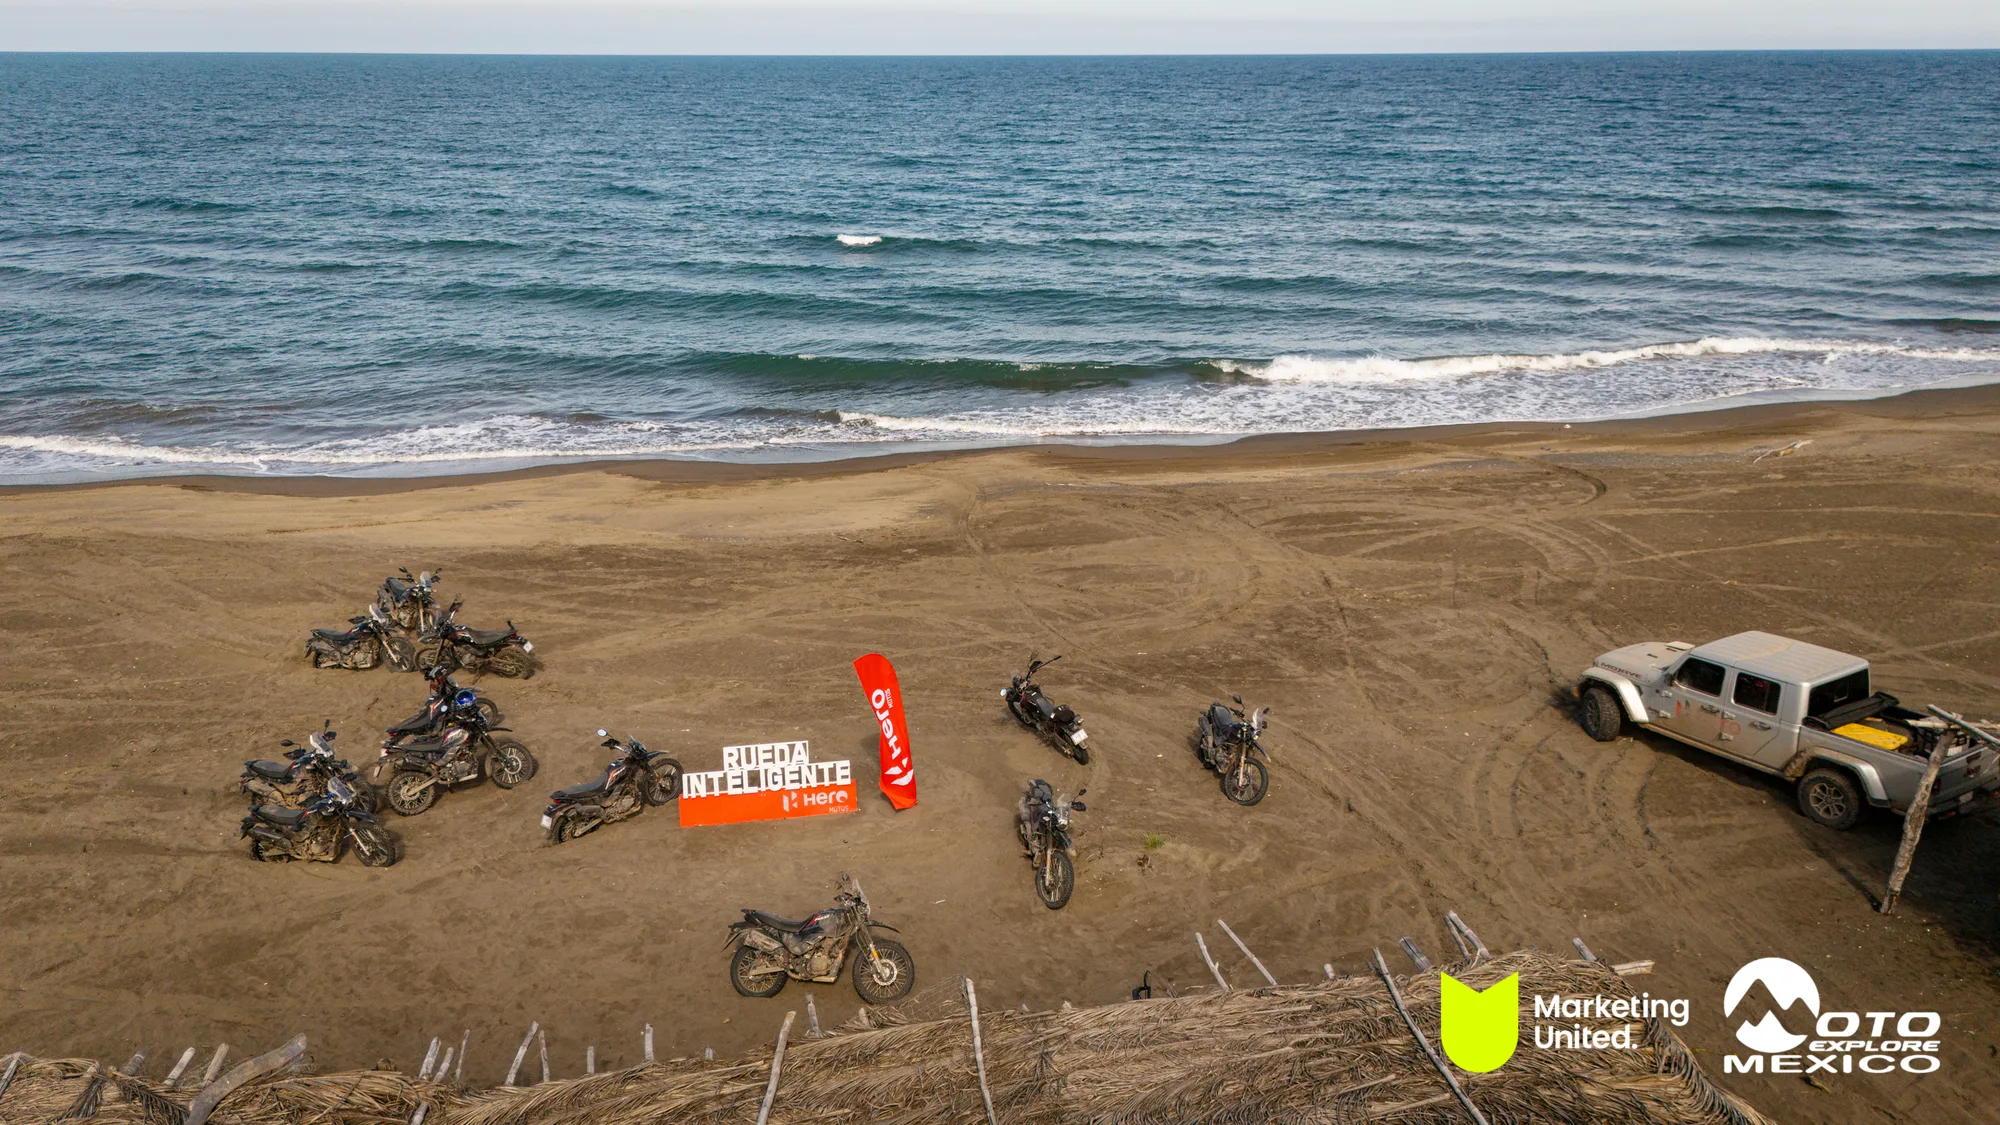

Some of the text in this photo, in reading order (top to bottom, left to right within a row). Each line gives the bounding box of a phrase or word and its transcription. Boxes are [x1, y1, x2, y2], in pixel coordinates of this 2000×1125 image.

[872, 689, 901, 760] Hero
[723, 741, 809, 770] RUEDA
[682, 760, 851, 799] INTELIGENTE
[803, 790, 848, 807] Hero
[828, 805, 849, 813] MOTOS
